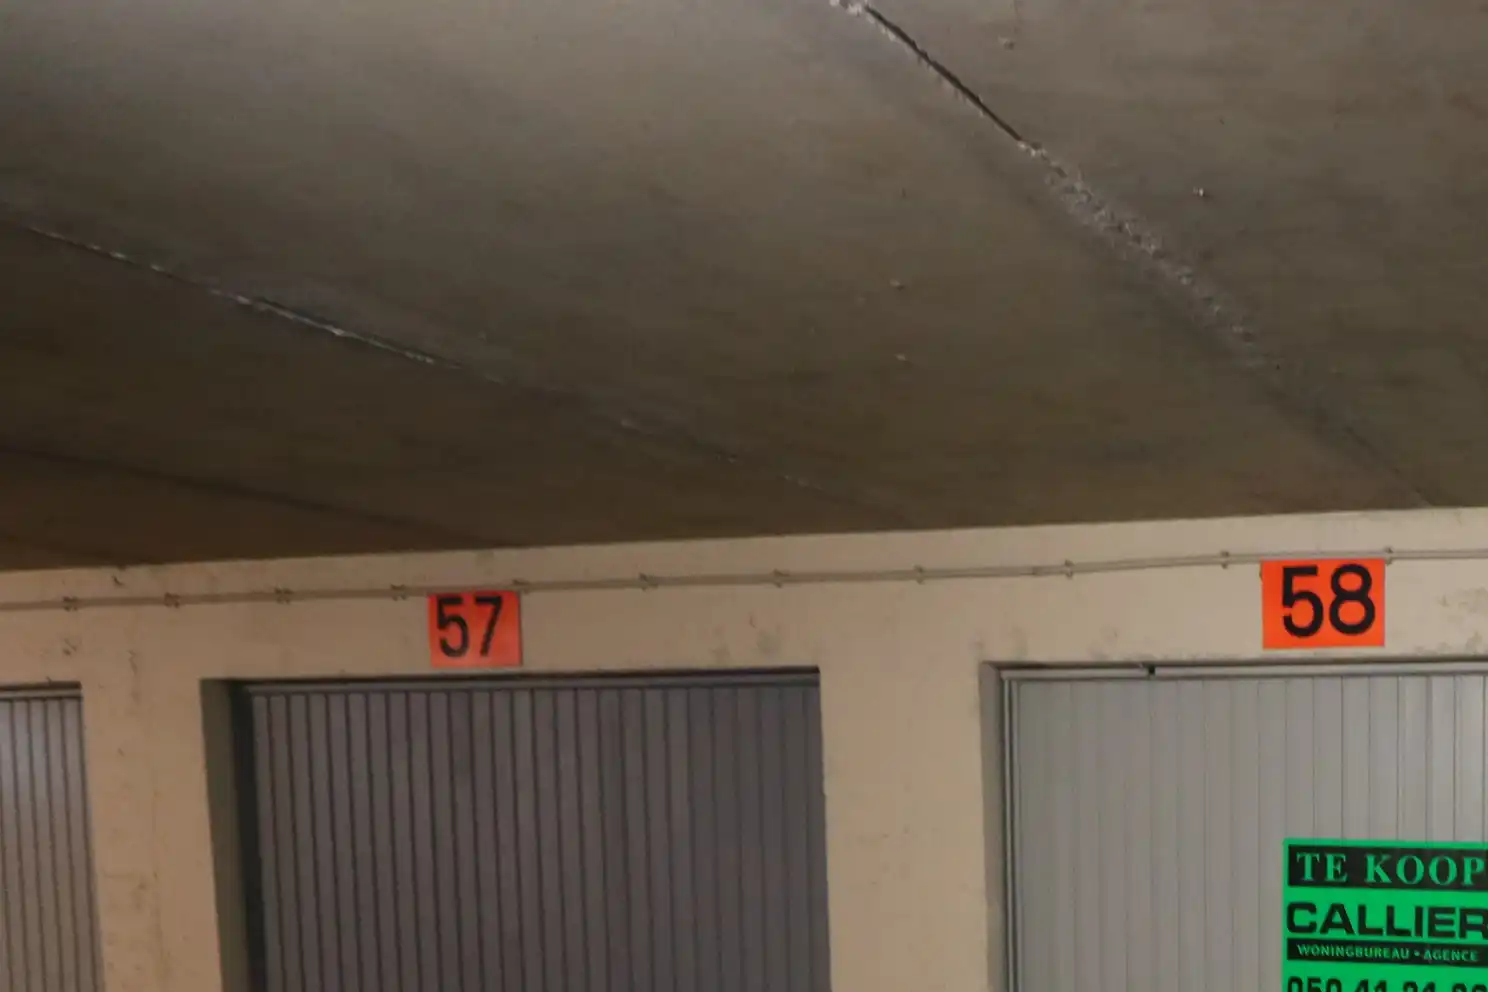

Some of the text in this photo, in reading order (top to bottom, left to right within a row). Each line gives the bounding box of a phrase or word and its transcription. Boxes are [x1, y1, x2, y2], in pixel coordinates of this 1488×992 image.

[1281, 564, 1376, 637] 58
[435, 595, 503, 659] 57
[1296, 852, 1486, 886] TE KOOP
[1297, 943, 1479, 962] WONINGBUREAU AGENCE
